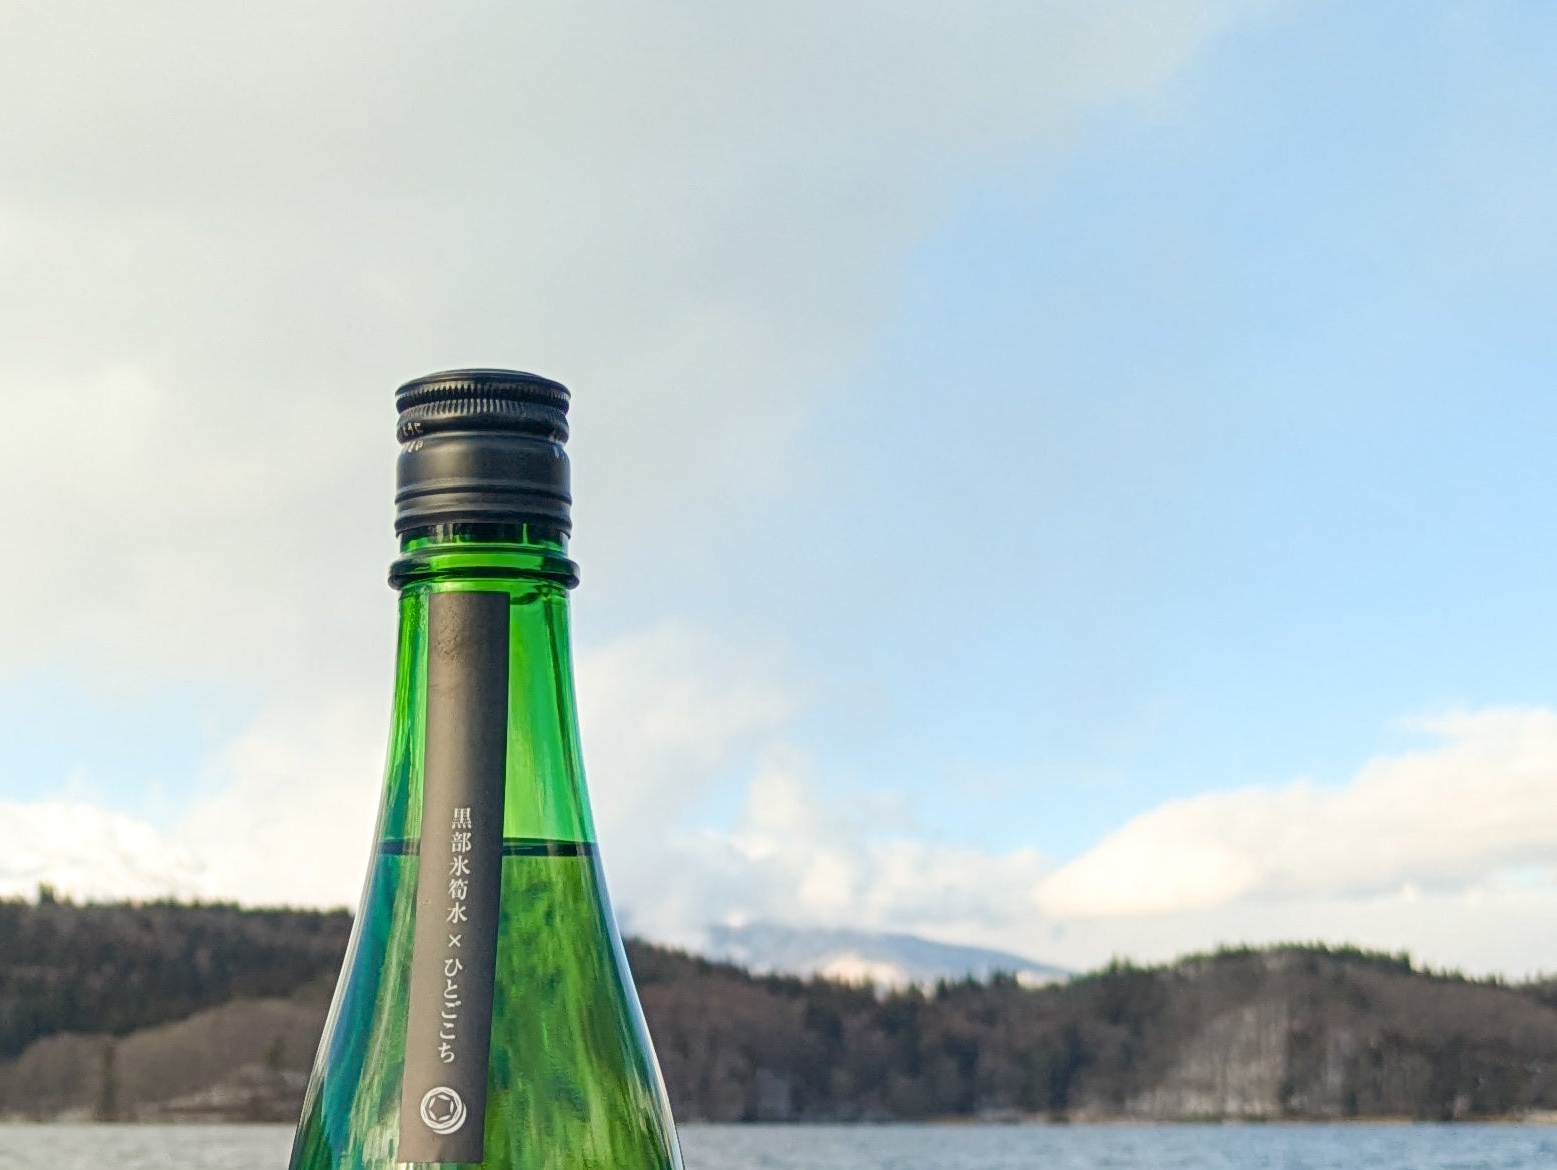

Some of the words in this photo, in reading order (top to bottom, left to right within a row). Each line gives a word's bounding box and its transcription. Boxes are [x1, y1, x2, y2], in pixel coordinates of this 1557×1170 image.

[445, 807, 473, 925] 黒部氷筍水
[437, 957, 464, 1064] ひとごこち
